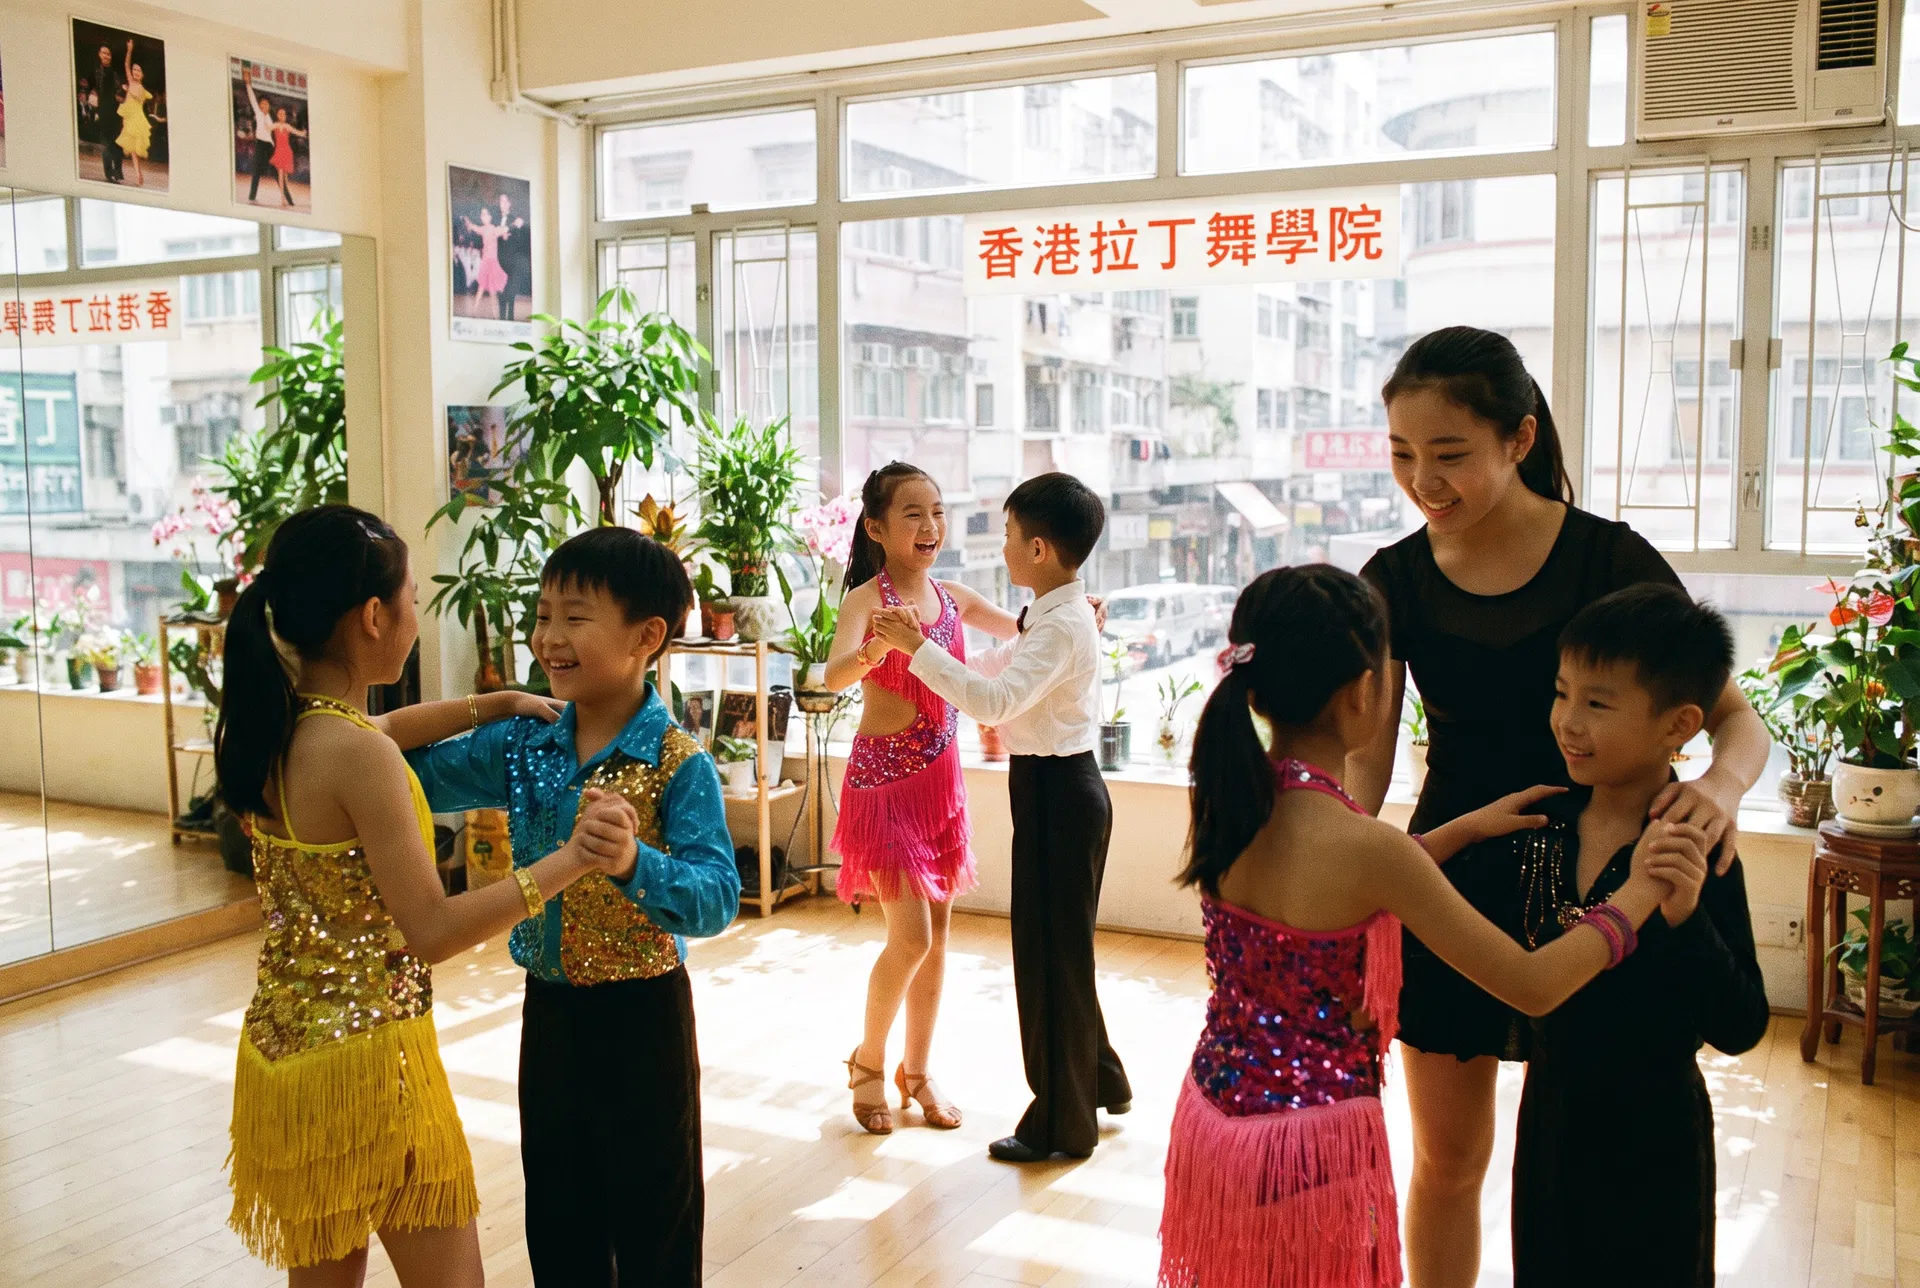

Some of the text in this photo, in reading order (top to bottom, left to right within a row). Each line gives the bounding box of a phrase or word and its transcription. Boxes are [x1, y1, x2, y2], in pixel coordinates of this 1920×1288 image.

[978, 203, 1383, 280] 香港拉丁舞學院
